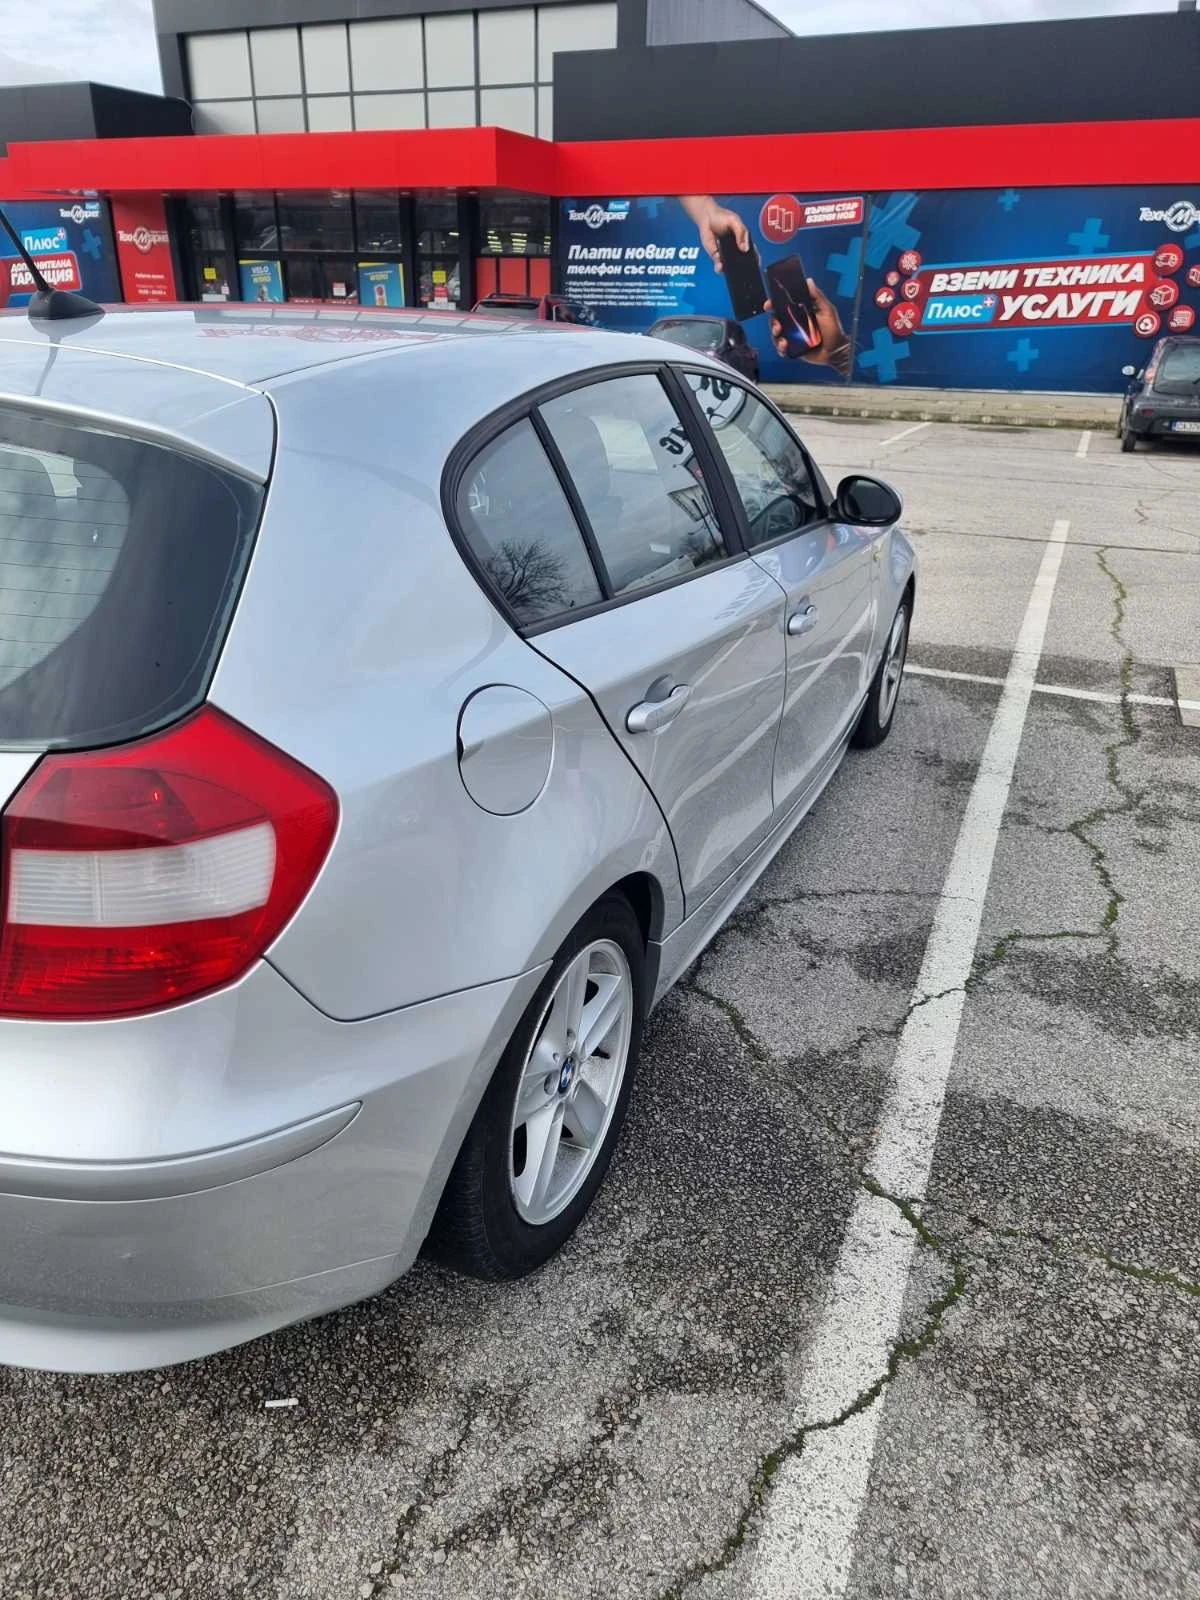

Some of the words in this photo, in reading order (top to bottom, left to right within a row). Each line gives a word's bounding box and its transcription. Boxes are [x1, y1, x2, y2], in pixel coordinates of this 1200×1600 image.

[567, 245, 622, 260] Плати
[624, 244, 675, 260] новия
[678, 247, 700, 260] си
[11, 269, 74, 286] ГАРНЦИЯ
[566, 263, 622, 277] телефон
[623, 265, 645, 275] със
[647, 265, 697, 277] стария
[930, 269, 1018, 293] ВЗЕМИ
[1022, 263, 1145, 288] ТЕХНИКА
[999, 290, 1144, 321] УСЛУГИ
